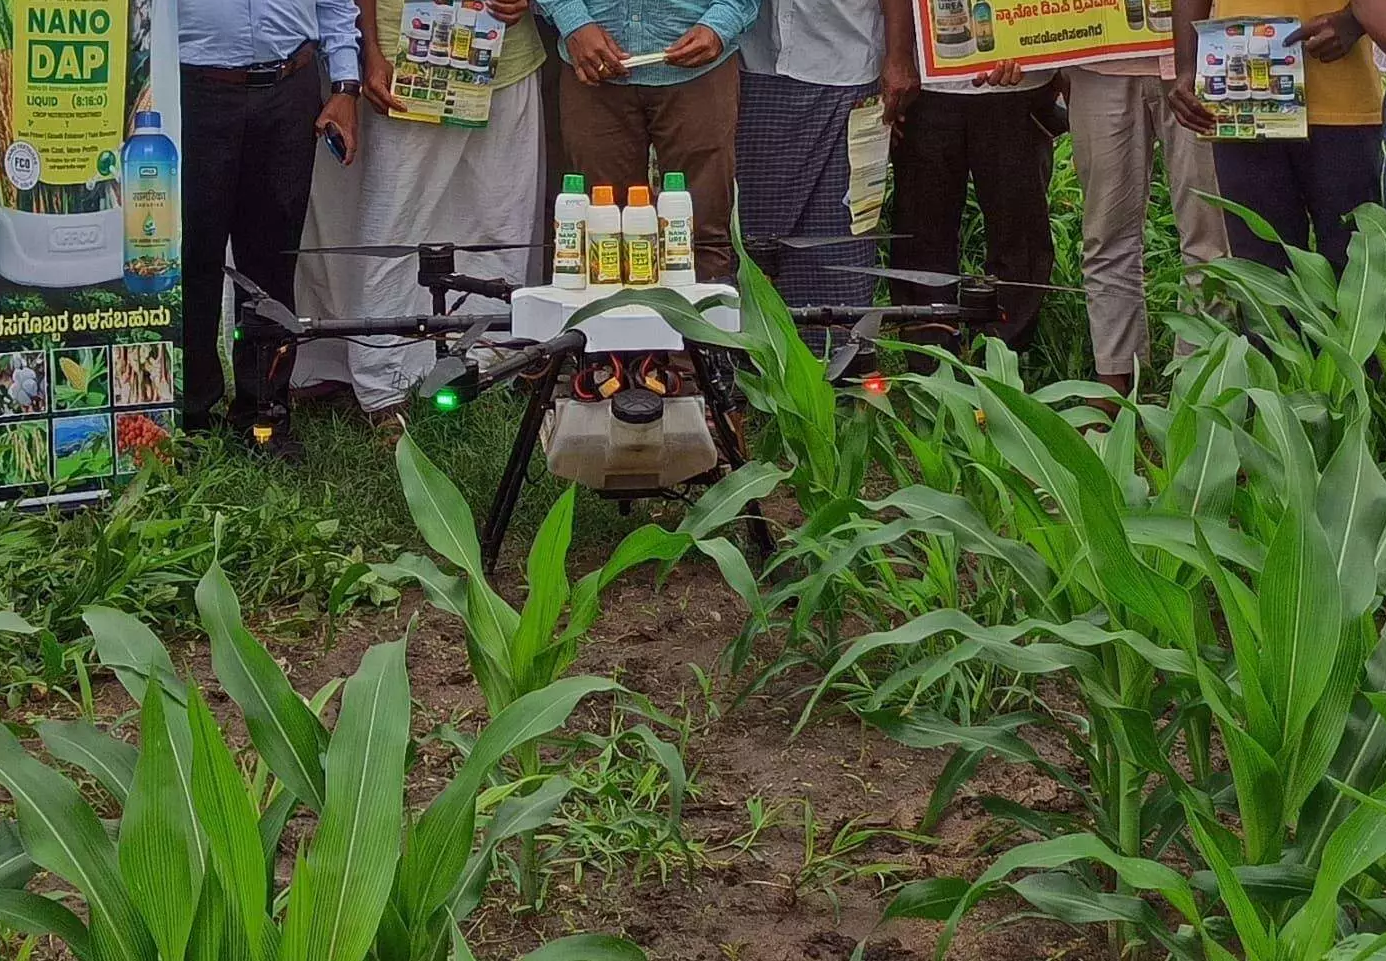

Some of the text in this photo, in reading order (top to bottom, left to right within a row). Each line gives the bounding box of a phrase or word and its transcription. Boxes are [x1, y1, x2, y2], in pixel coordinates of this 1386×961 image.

[939, 0, 963, 10] UREA
[996, 3, 1038, 25] ನ್ಯಾನೋ
[1041, 0, 1070, 15] ಡಿಎಪಿ
[28, 7, 111, 34] NANO
[32, 44, 104, 79] DAP
[26, 96, 58, 107] LIQUID
[15, 157, 30, 169] FCO
[72, 305, 171, 331] ಬಳಸಬಹುದು
